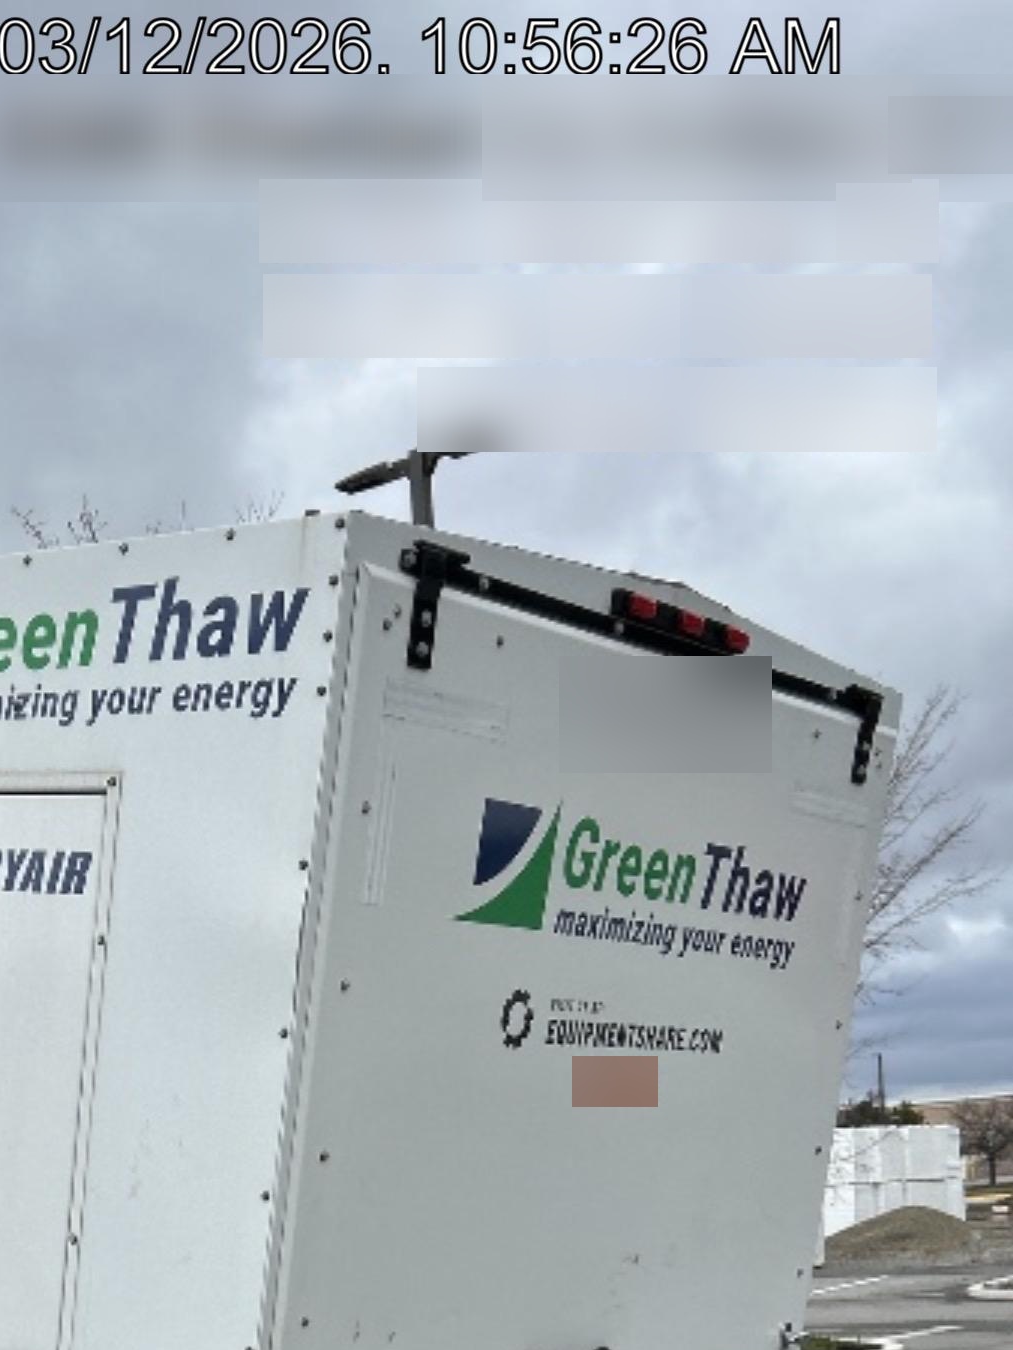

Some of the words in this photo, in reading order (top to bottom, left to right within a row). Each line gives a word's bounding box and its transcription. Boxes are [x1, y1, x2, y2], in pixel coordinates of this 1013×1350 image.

[87, 683, 162, 727] your
[172, 676, 298, 718] energy
[553, 906, 676, 956] maximizing
[678, 923, 727, 958] your
[730, 932, 796, 969] energy
